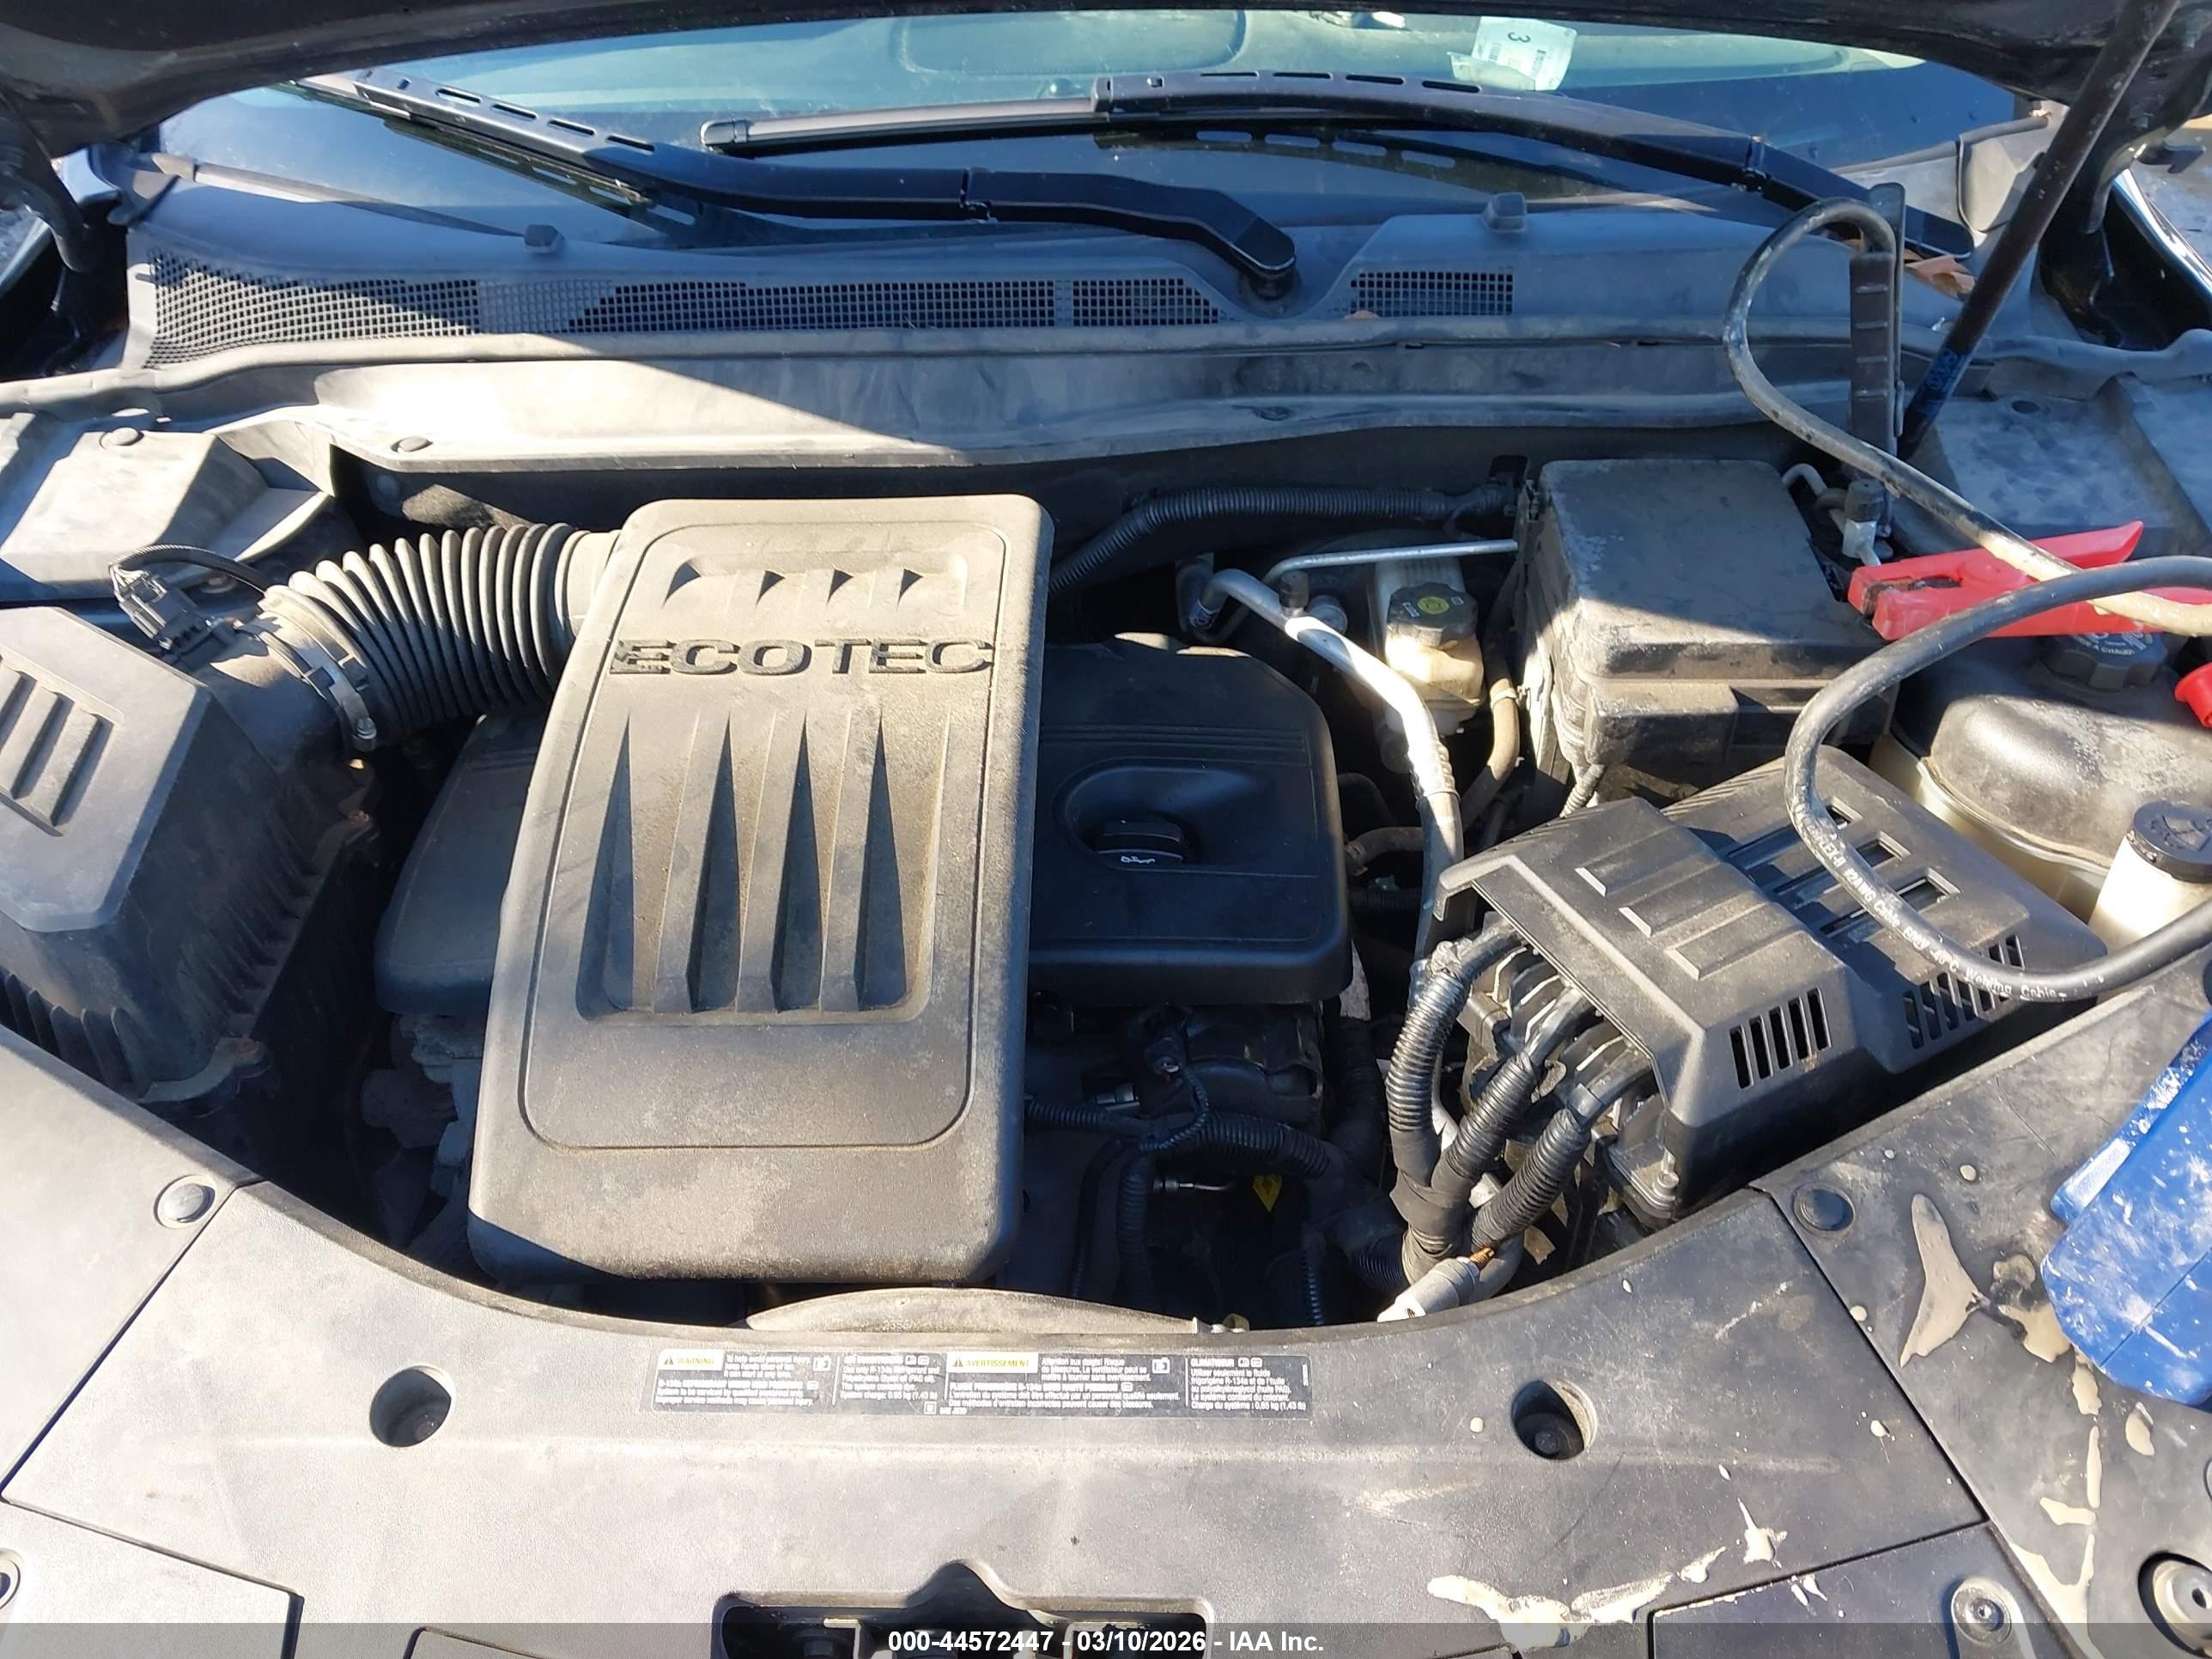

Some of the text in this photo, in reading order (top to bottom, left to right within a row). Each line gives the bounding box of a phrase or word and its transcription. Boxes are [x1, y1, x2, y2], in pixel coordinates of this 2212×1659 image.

[609, 638, 994, 676] ECOTEC
[676, 1357, 714, 1365] WARNING
[965, 1359, 1029, 1368] AVERTISSEMENT
